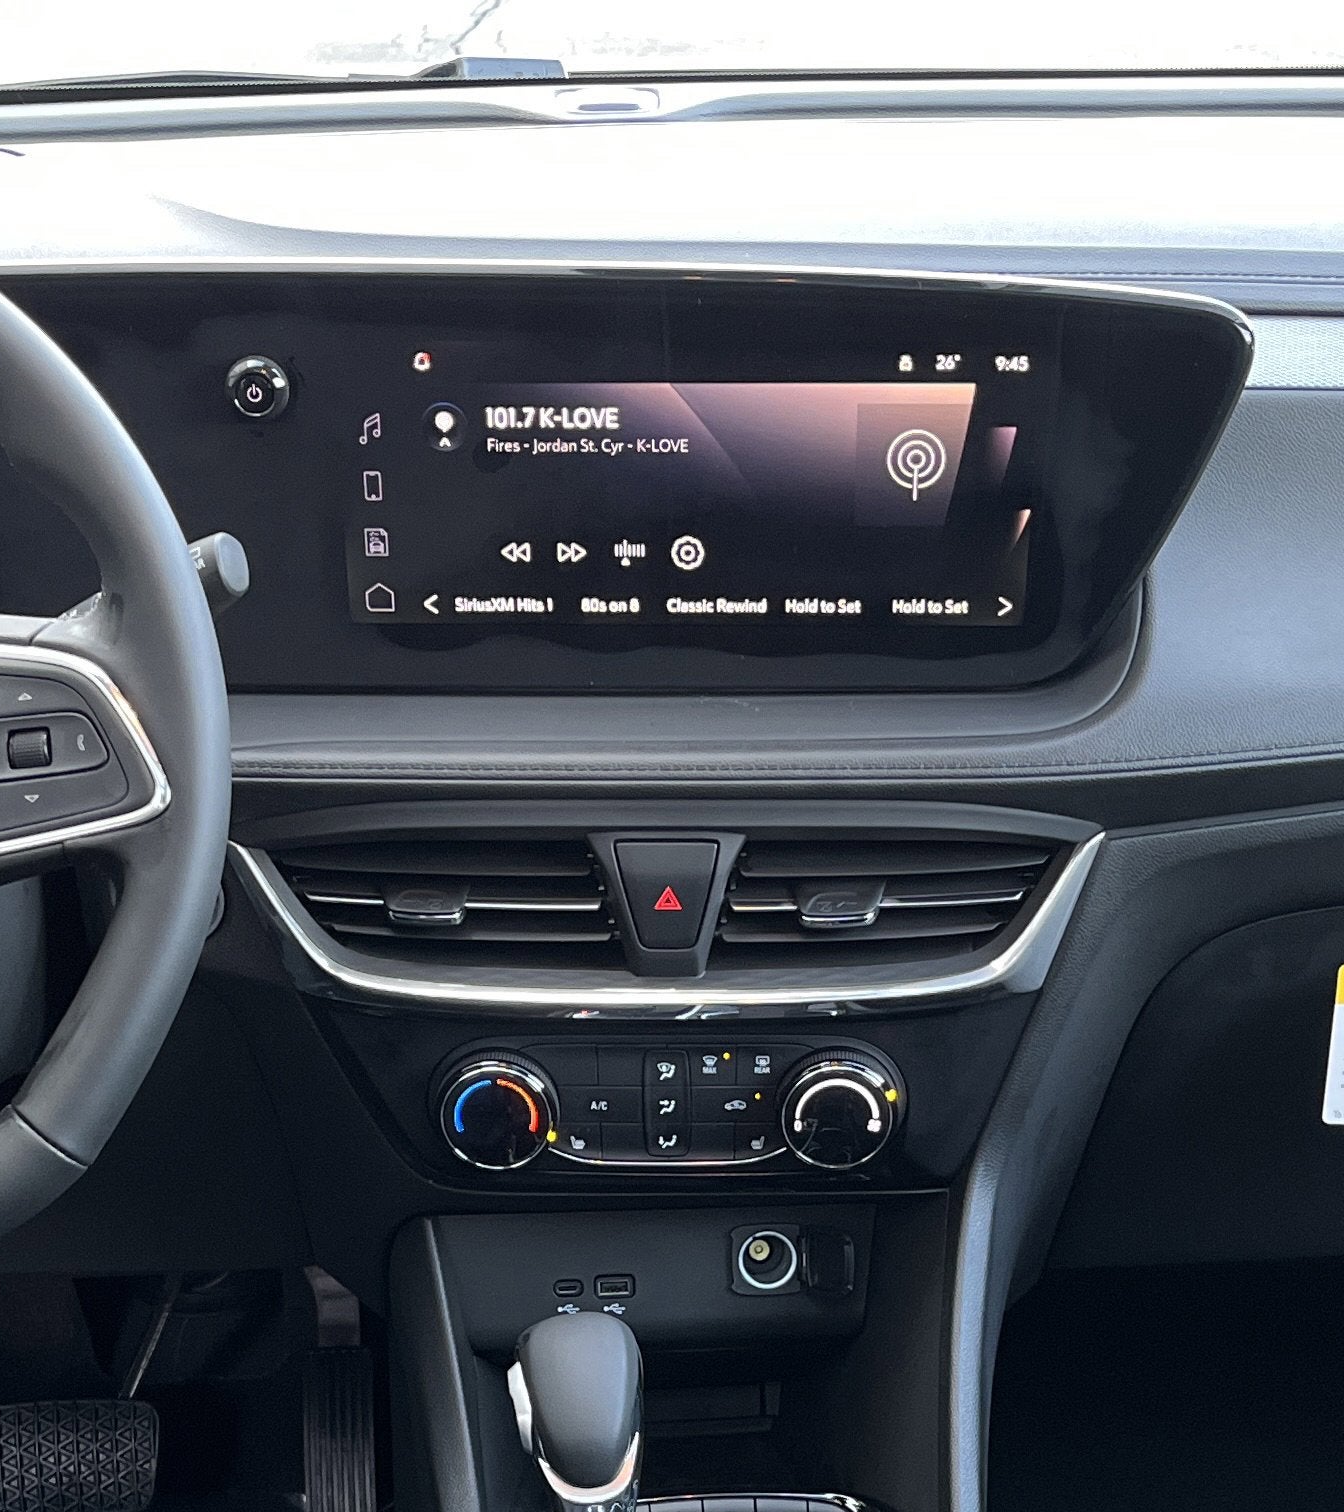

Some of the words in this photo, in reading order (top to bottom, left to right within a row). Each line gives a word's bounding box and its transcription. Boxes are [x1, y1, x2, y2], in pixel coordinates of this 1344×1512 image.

[994, 355, 1029, 371] 9:45
[485, 406, 535, 429] 101.7
[539, 407, 620, 429] K-LOVE
[487, 438, 520, 453] Fires
[532, 438, 577, 455] Jordan
[580, 438, 598, 453] St.
[601, 438, 624, 456] Cyr
[636, 438, 689, 453] K-LOVE
[455, 597, 515, 612] SiriusXM
[516, 597, 545, 612] Hits
[608, 600, 628, 612] on
[666, 598, 714, 613] Classic
[716, 597, 768, 613] Rewind
[785, 598, 818, 613] Hold
[820, 598, 836, 613] to
[837, 598, 862, 613] Set
[892, 599, 926, 614] Hold
[928, 599, 943, 614] to
[944, 599, 969, 614] Set
[590, 1100, 608, 1111] A/C
